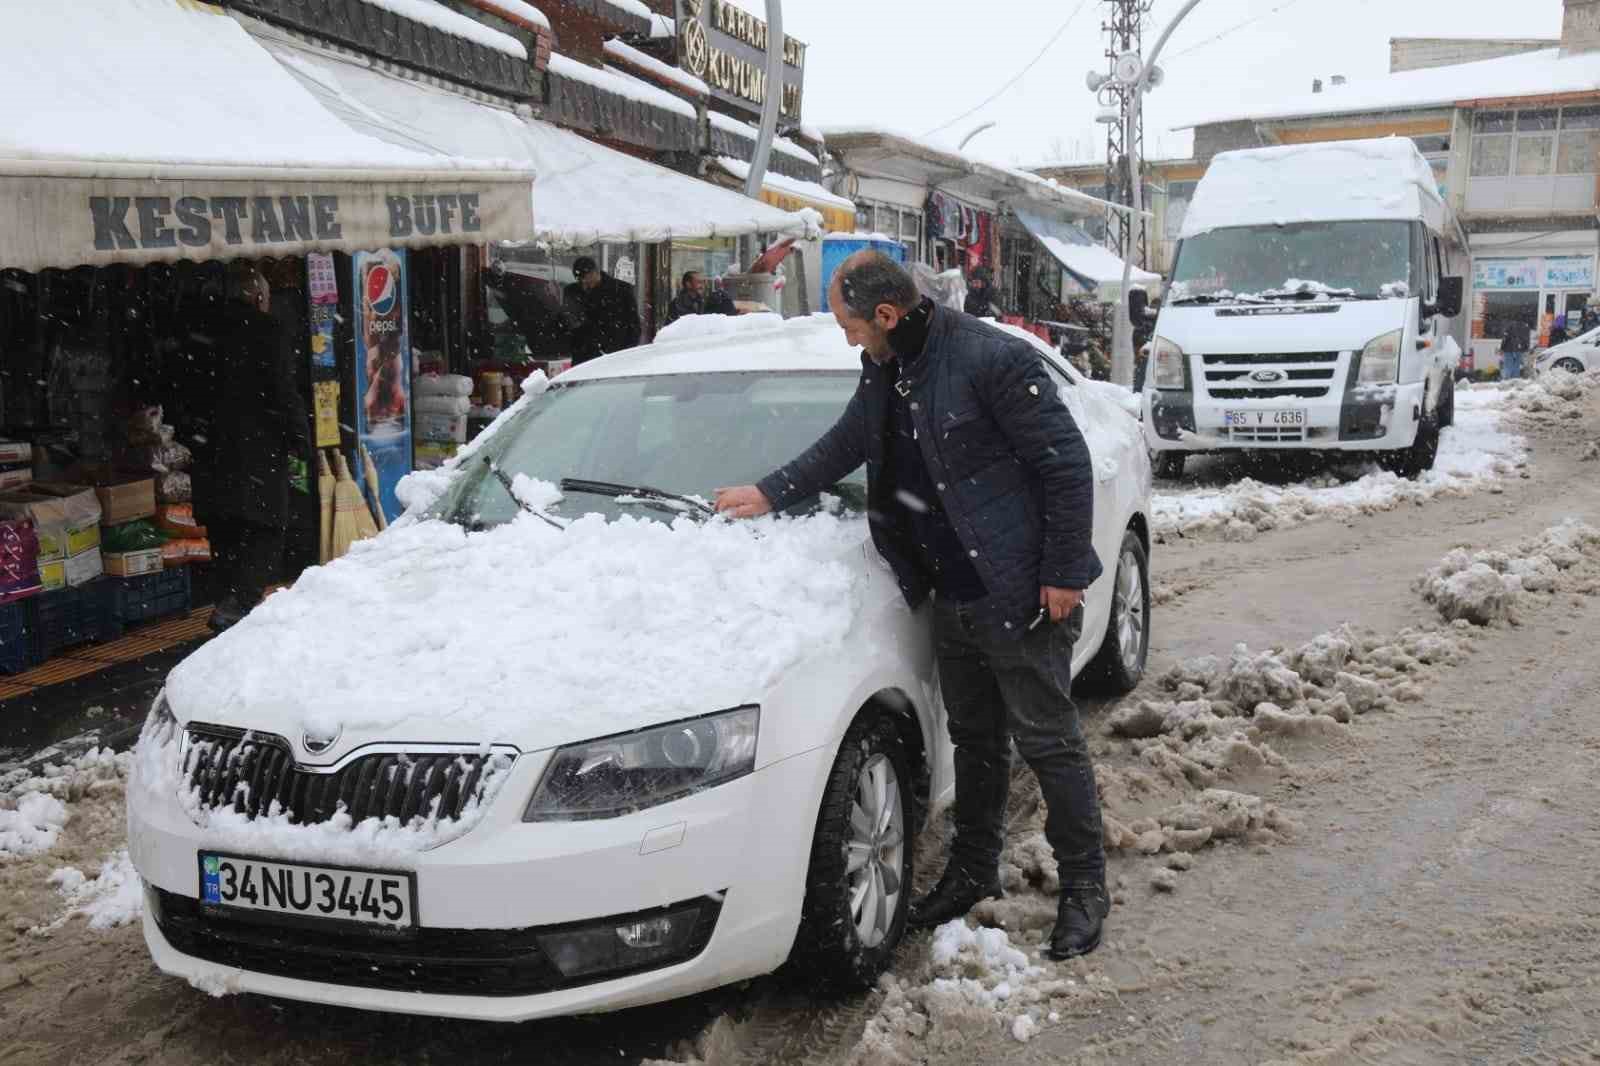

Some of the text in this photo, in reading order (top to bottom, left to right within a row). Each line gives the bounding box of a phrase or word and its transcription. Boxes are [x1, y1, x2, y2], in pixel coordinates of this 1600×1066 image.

[90, 193, 480, 249] KESTANE BÜFE
[1233, 412, 1247, 425] 65
[1273, 411, 1302, 424] 4636
[206, 862, 403, 921] TR 34NU3445
